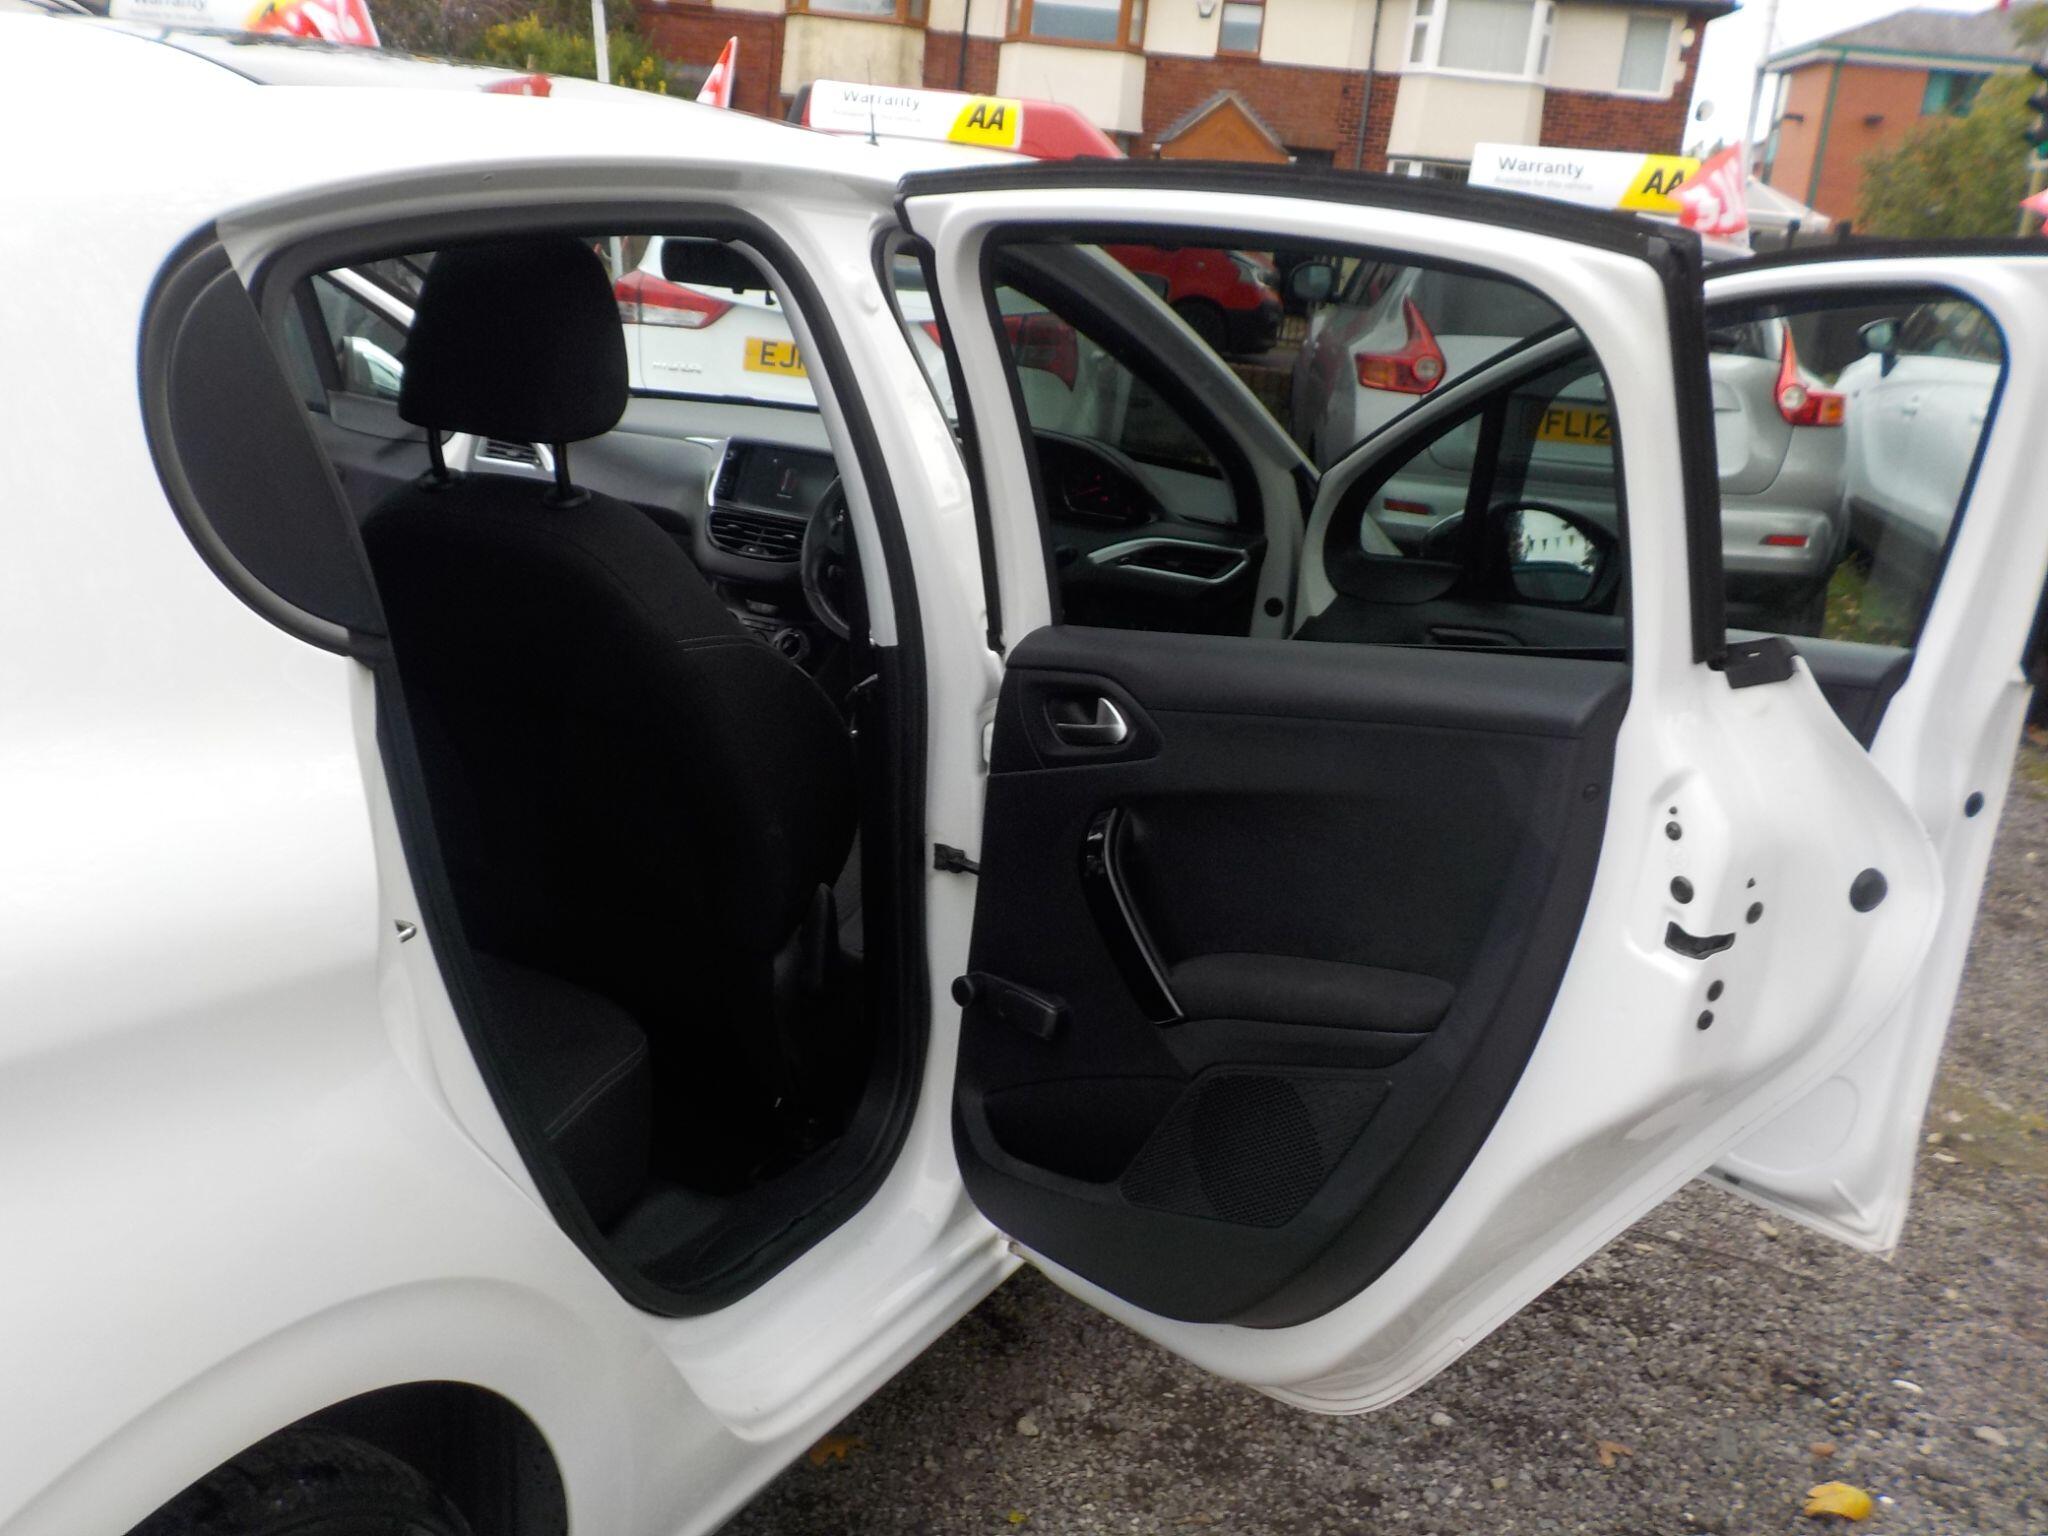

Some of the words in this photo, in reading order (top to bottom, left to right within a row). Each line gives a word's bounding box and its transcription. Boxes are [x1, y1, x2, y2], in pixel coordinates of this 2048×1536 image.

[134, 0, 207, 12] arranty
[844, 89, 920, 111] Warranty
[966, 104, 1005, 131] AA
[1498, 156, 1584, 179] Warranty
